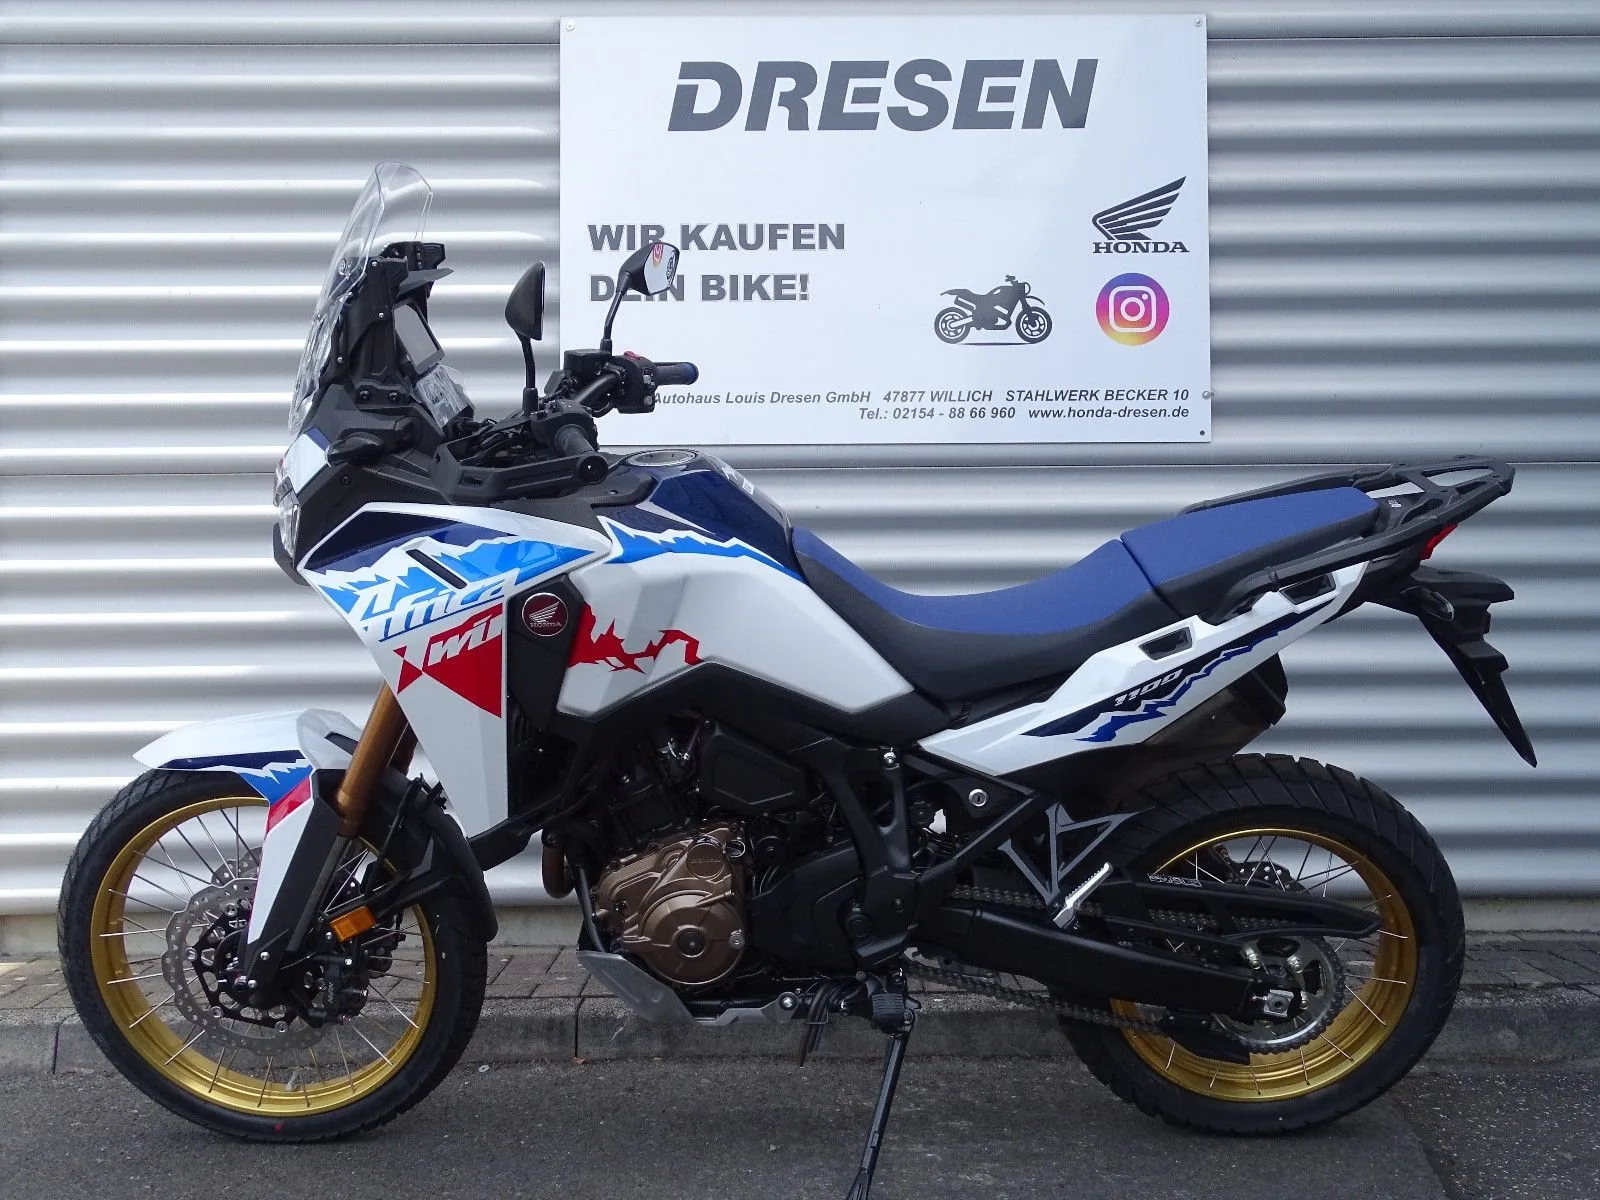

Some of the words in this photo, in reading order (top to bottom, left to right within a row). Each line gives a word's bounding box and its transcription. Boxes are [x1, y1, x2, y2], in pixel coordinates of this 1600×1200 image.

[667, 58, 1098, 131] DRESEN
[588, 224, 665, 251] WIR
[680, 223, 845, 250] KAUFEN
[1092, 241, 1190, 254] HONDA
[590, 274, 685, 301] DN
[701, 274, 809, 301] BIKE!
[655, 391, 721, 404] Autohaus
[725, 391, 766, 404] Louis
[770, 391, 822, 404] Dresen
[825, 391, 872, 403] GmbH
[883, 390, 925, 403] 47877
[930, 390, 993, 402] WILLICH
[1005, 389, 1100, 402] STAHLWERK
[1104, 389, 1168, 401] BECKER
[1173, 389, 1189, 401] 10
[859, 407, 888, 420] Tel.:
[893, 407, 935, 419] 02154
[948, 407, 965, 419] 88
[970, 406, 987, 419] 66
[990, 406, 1016, 419] 960
[1028, 405, 1190, 419] www.honda-dresen.de
[1114, 668, 1184, 706] 1100
